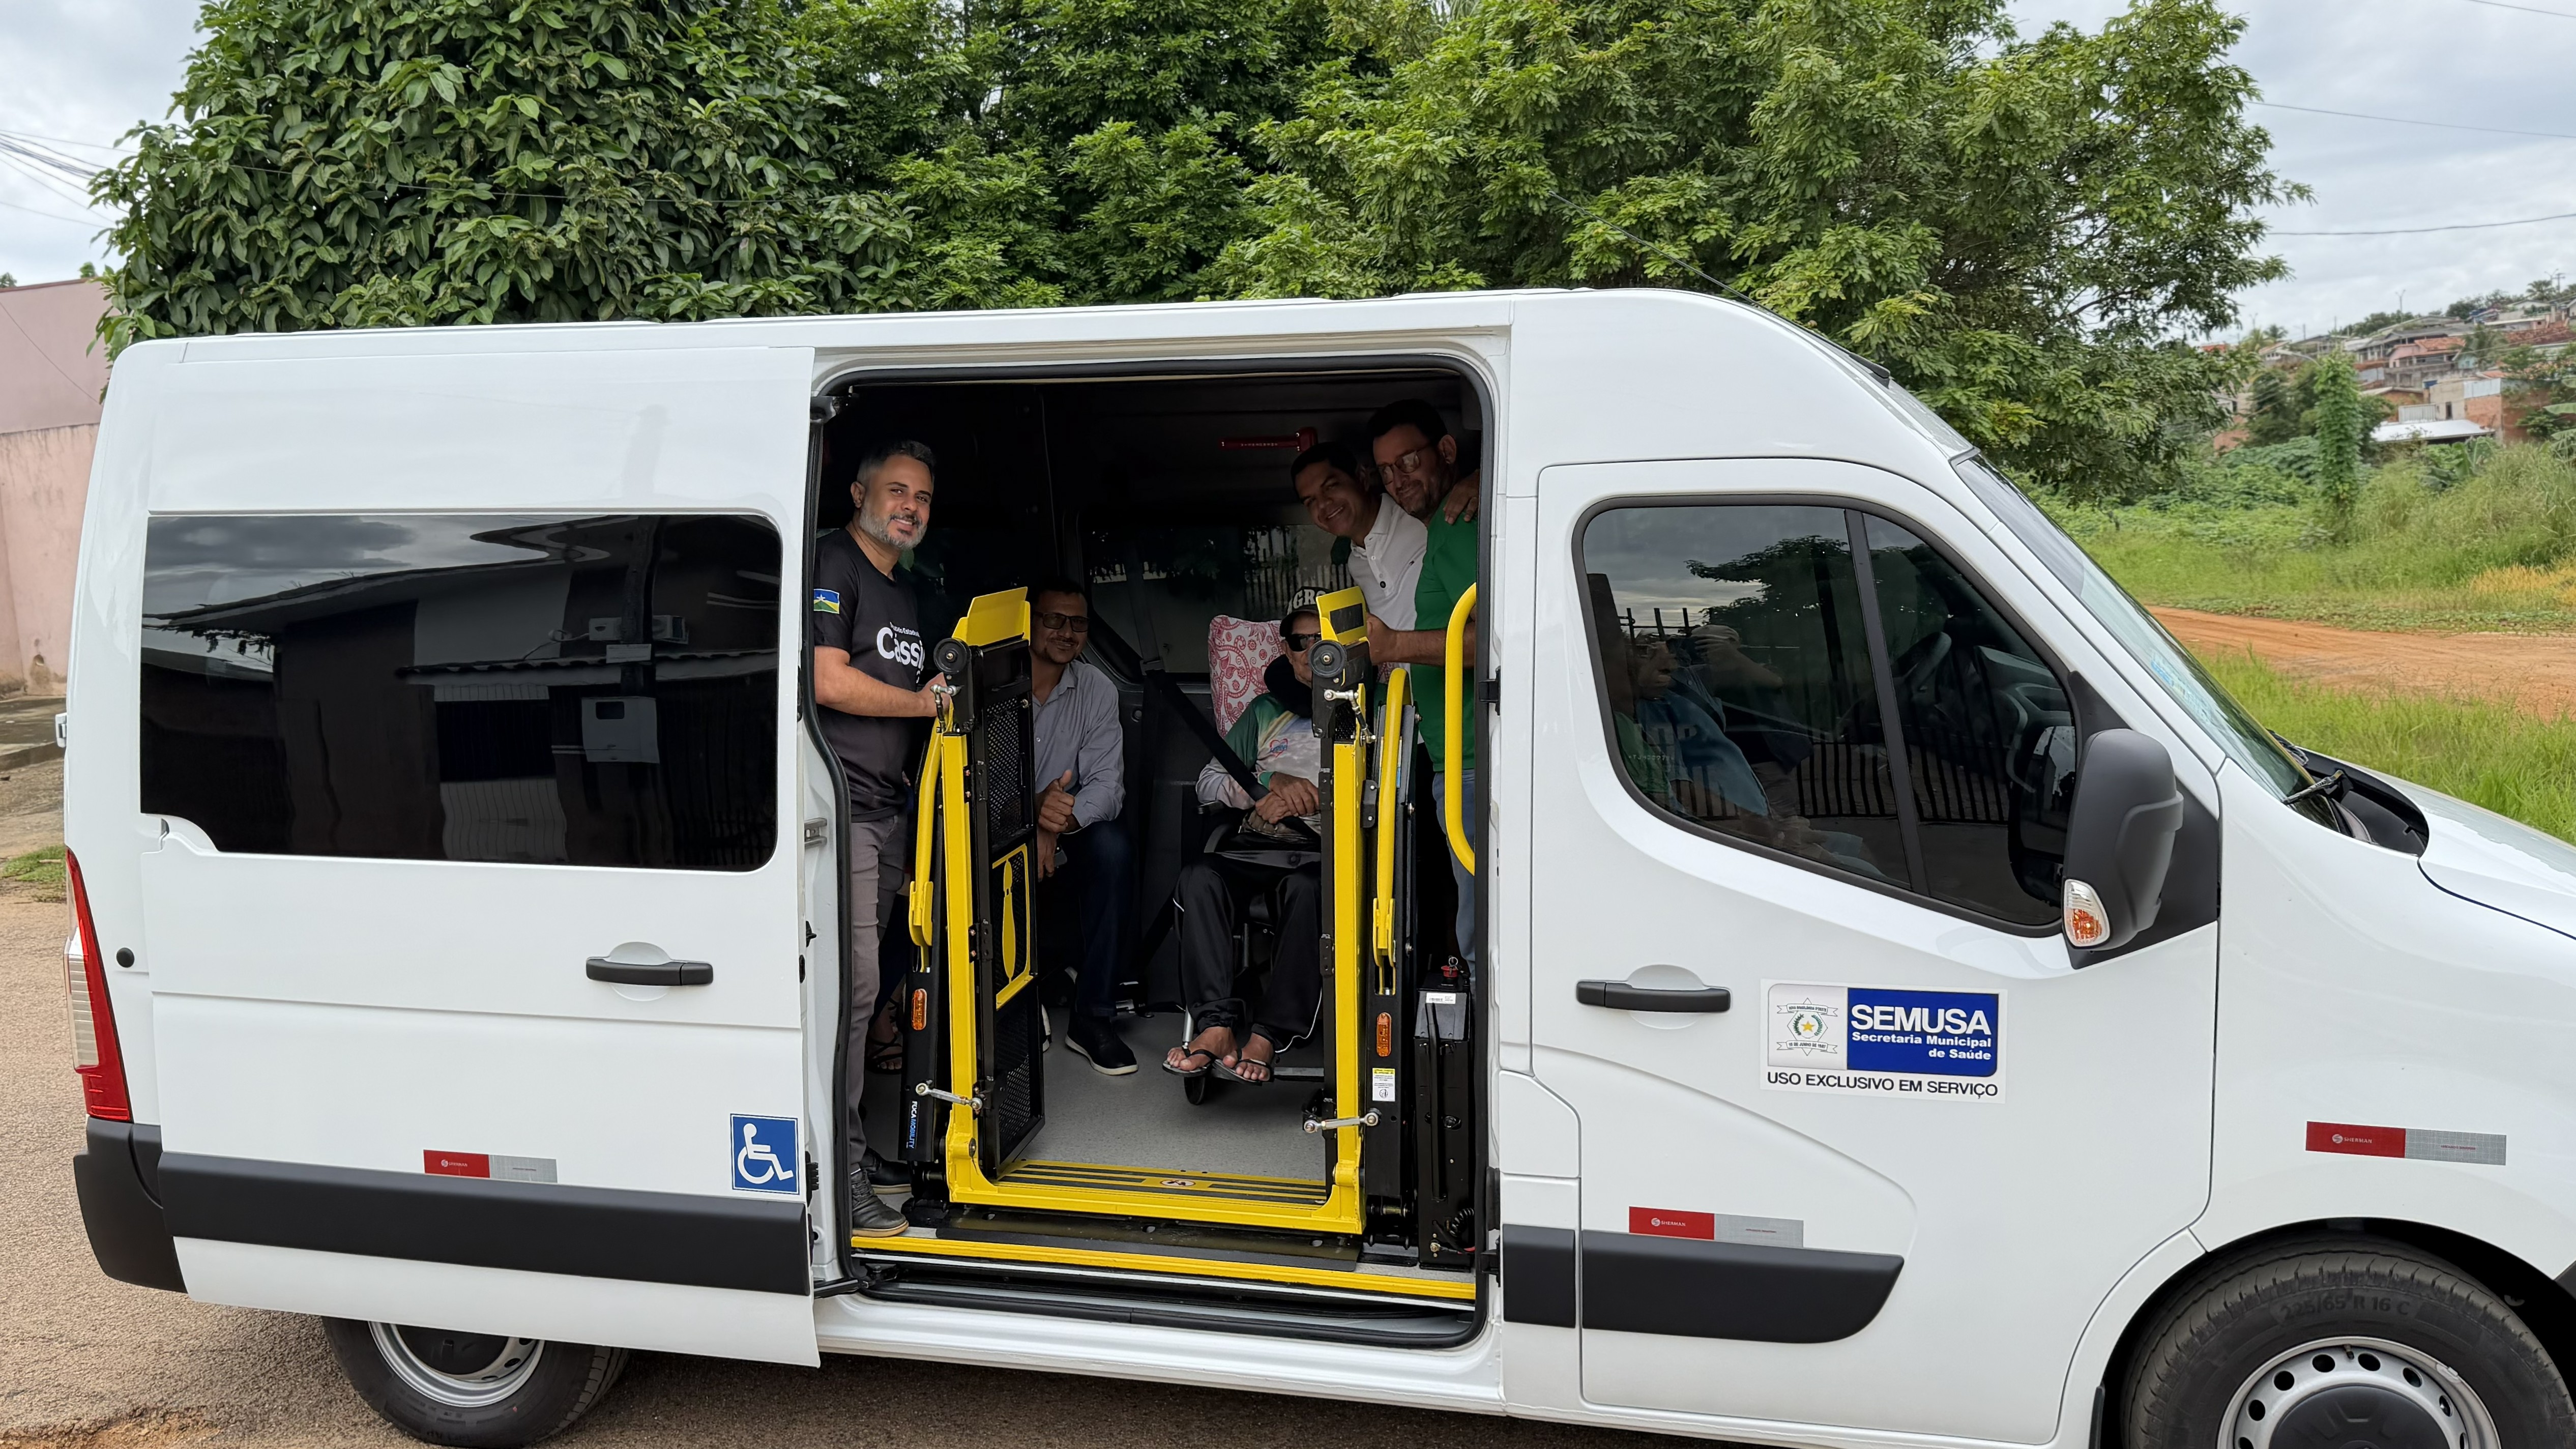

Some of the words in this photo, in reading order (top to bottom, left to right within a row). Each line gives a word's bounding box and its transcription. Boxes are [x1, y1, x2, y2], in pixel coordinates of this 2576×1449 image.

[1287, 589, 1326, 615] GR
[876, 627, 925, 671] Cássi
[1851, 1004, 1992, 1034] SEMUSA
[1852, 1032, 1922, 1044] Secretaria
[1926, 1035, 1992, 1048] Municipal
[1928, 1048, 1946, 1058] de
[1949, 1048, 1992, 1060] Saúde
[1768, 1071, 1801, 1085] USO
[1806, 1075, 1894, 1091] EXCLUSIVO
[1899, 1080, 1922, 1092] EM
[1927, 1082, 1998, 1099] SERVIÇO
[2280, 1294, 2347, 1320] 225/65
[2353, 1296, 2367, 1310] R
[2372, 1296, 2391, 1312] 16
[2396, 1300, 2411, 1316] C
